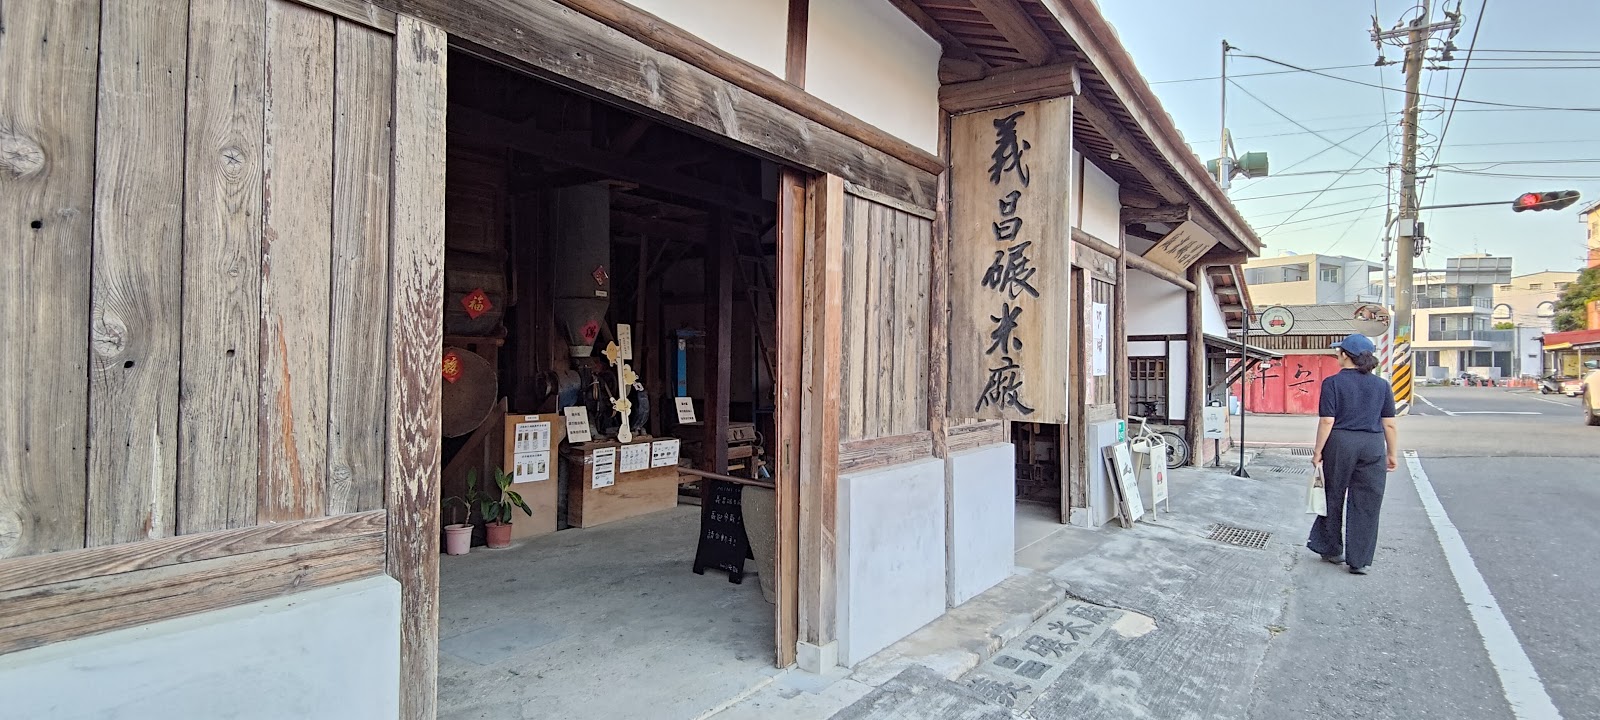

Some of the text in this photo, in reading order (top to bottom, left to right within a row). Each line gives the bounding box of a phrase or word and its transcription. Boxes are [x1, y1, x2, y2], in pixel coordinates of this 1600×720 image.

[468, 294, 484, 312] 福
[975, 110, 1040, 416] 義昌碾米廠
